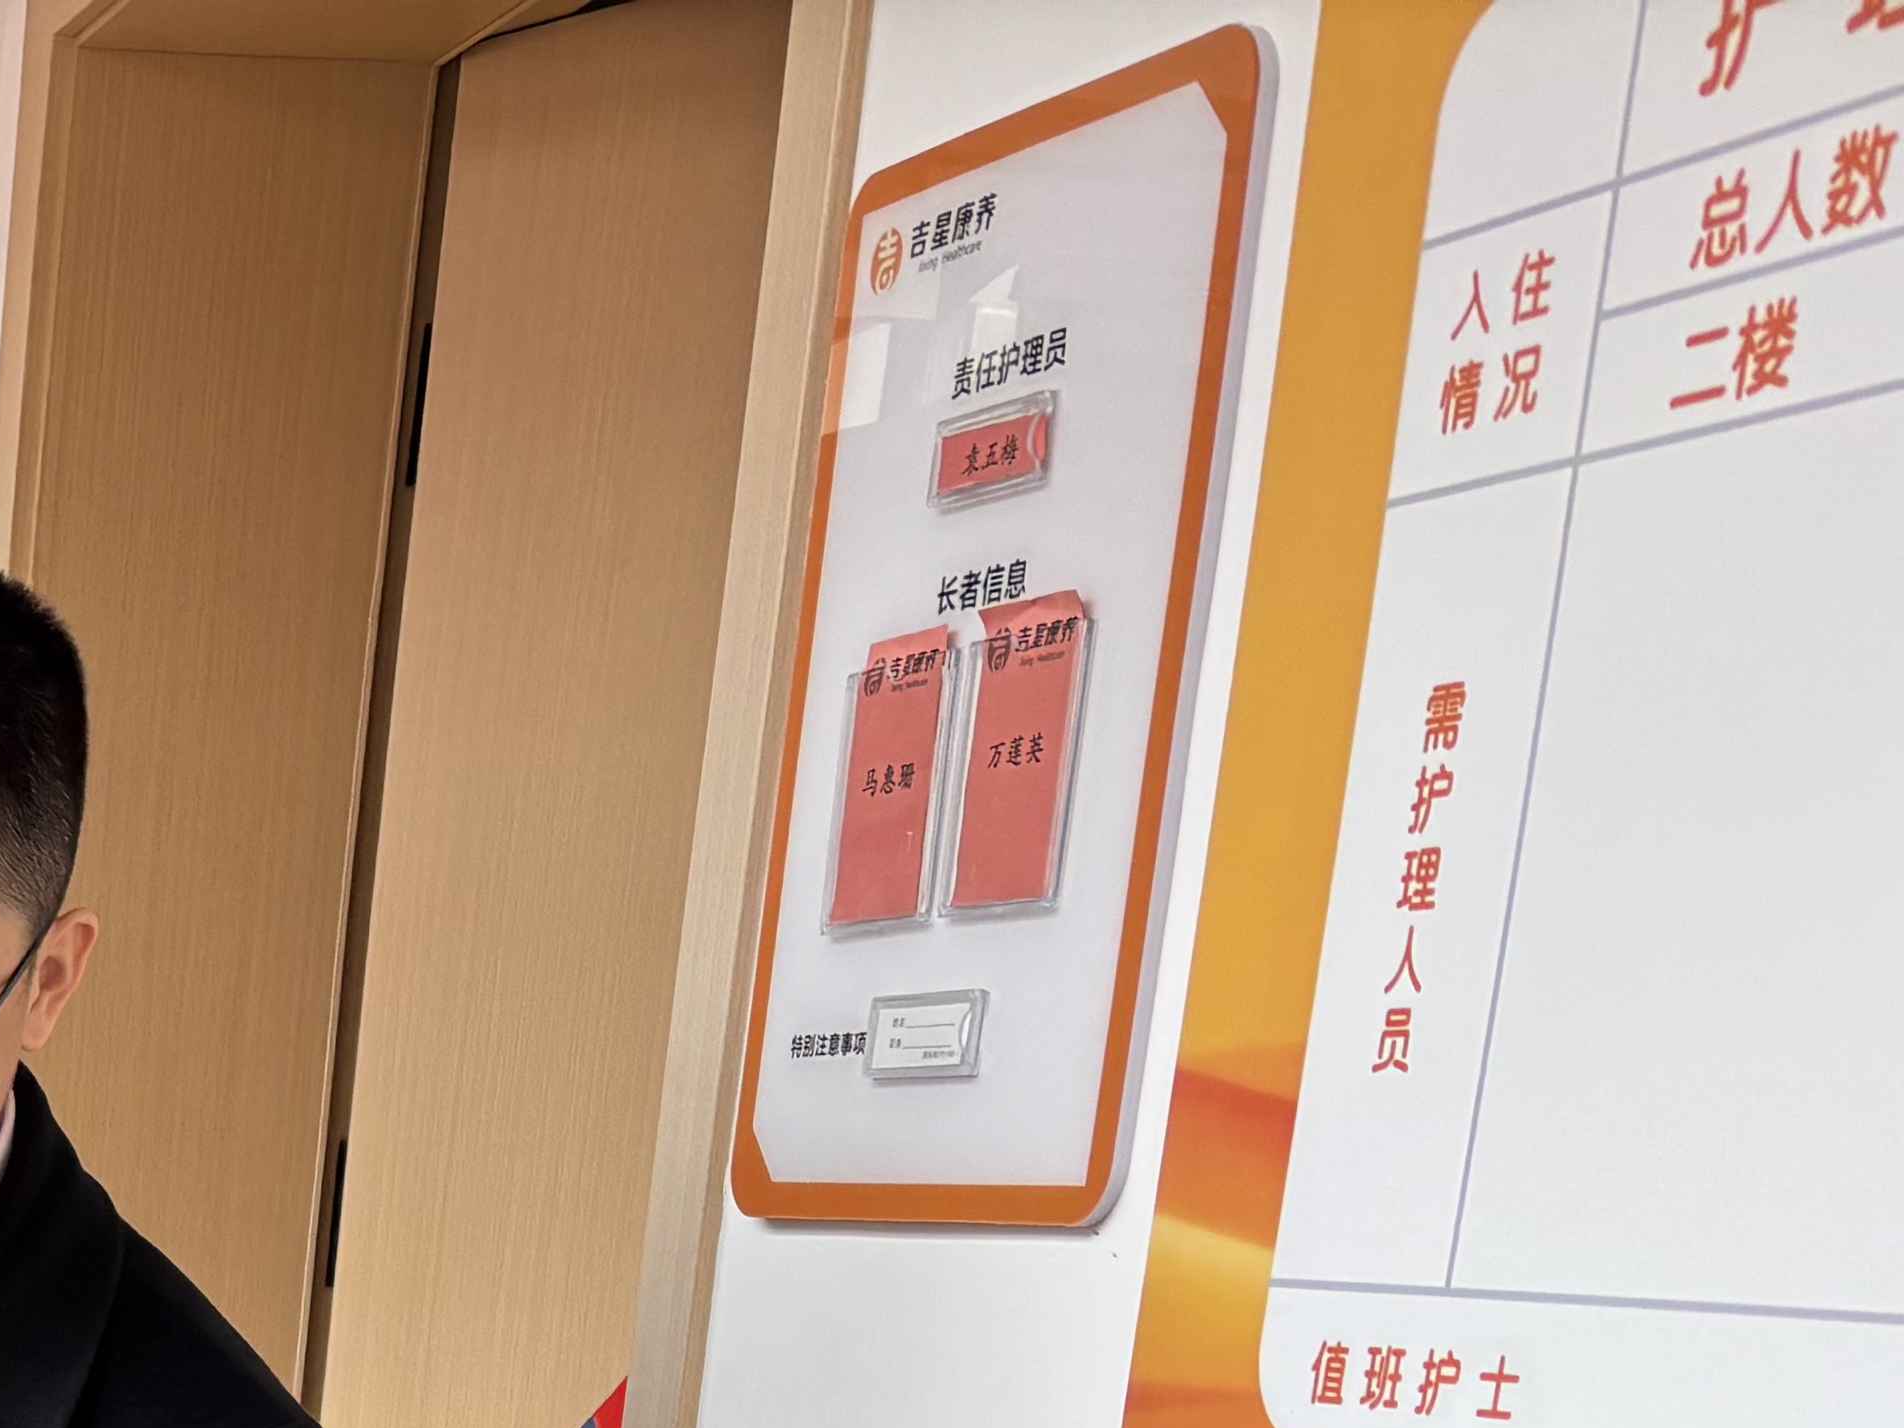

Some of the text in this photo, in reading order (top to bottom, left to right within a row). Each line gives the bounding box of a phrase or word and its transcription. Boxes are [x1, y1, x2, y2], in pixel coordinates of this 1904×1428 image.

[910, 193, 998, 259] 吉星康养
[1689, 124, 1899, 272] 总人数
[1450, 249, 1556, 341] 入住
[951, 327, 1068, 399] 责任护理员
[1439, 344, 1542, 435] 情况
[1669, 296, 1799, 410] 二楼
[937, 559, 1028, 615] 长者信息
[1372, 681, 1466, 1074] 需护理人员
[791, 1032, 868, 1060] 特别注意事项
[1310, 1340, 1521, 1421] 值班护士
